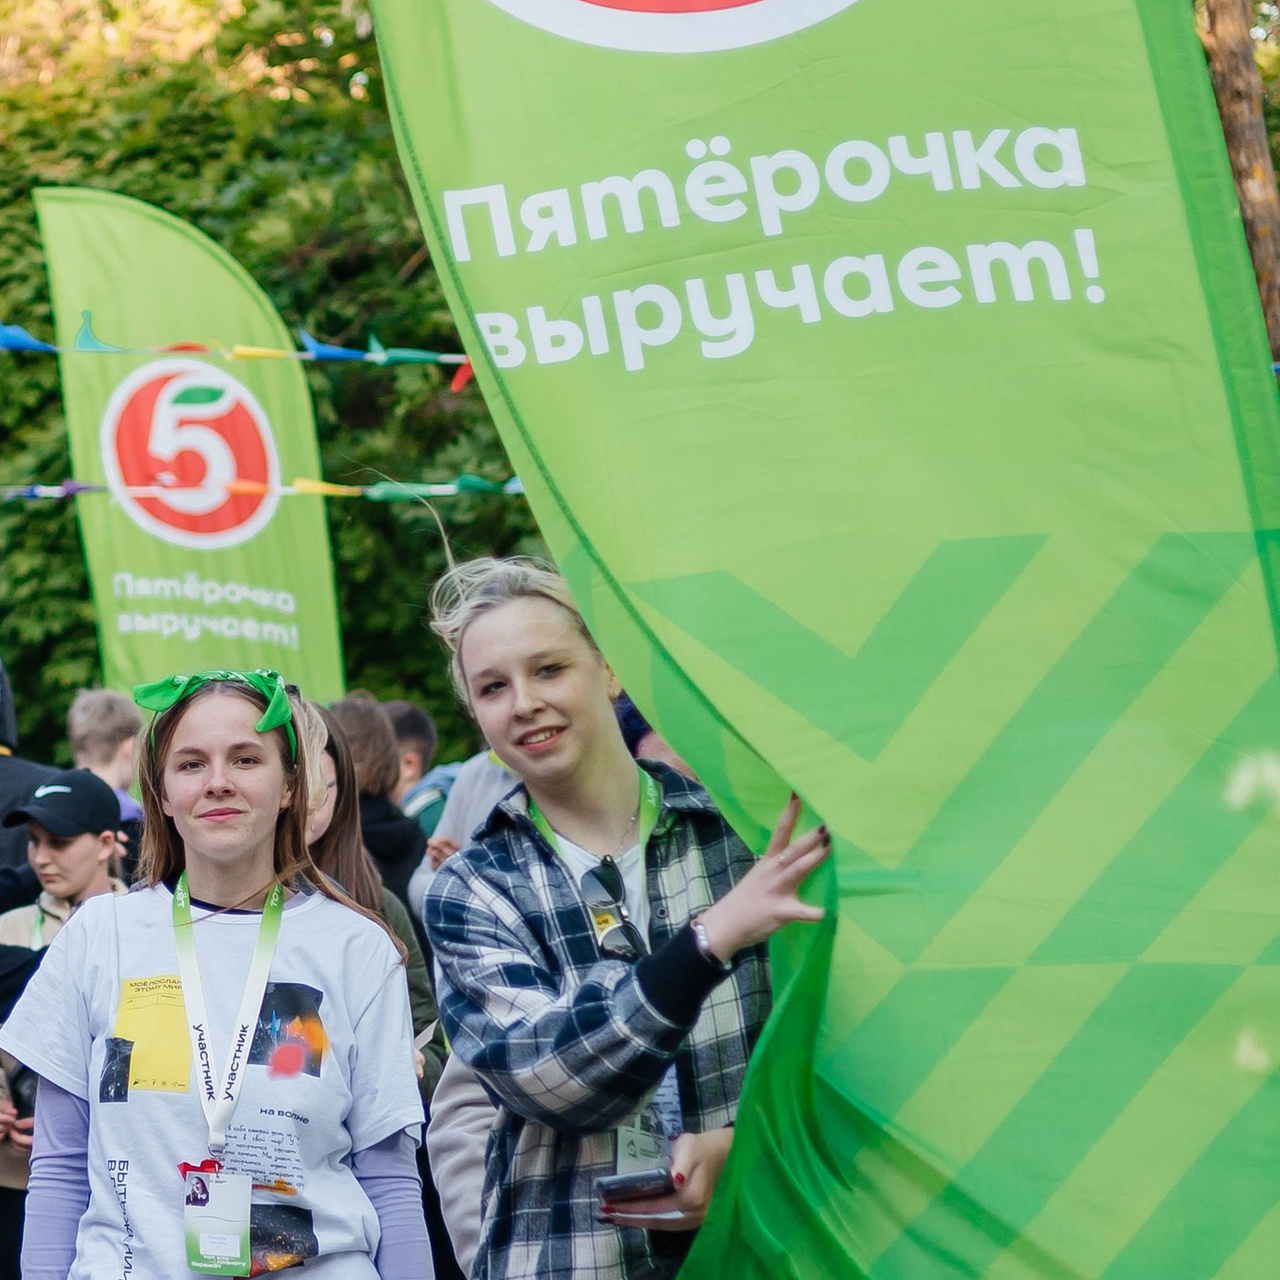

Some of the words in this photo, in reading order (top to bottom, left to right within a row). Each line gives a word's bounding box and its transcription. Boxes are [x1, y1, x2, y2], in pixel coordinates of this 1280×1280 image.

[444, 125, 1086, 262] Пятёрочка
[474, 228, 1106, 372] выручает!
[193, 1023, 216, 1102] участник
[223, 1024, 250, 1102] участник
